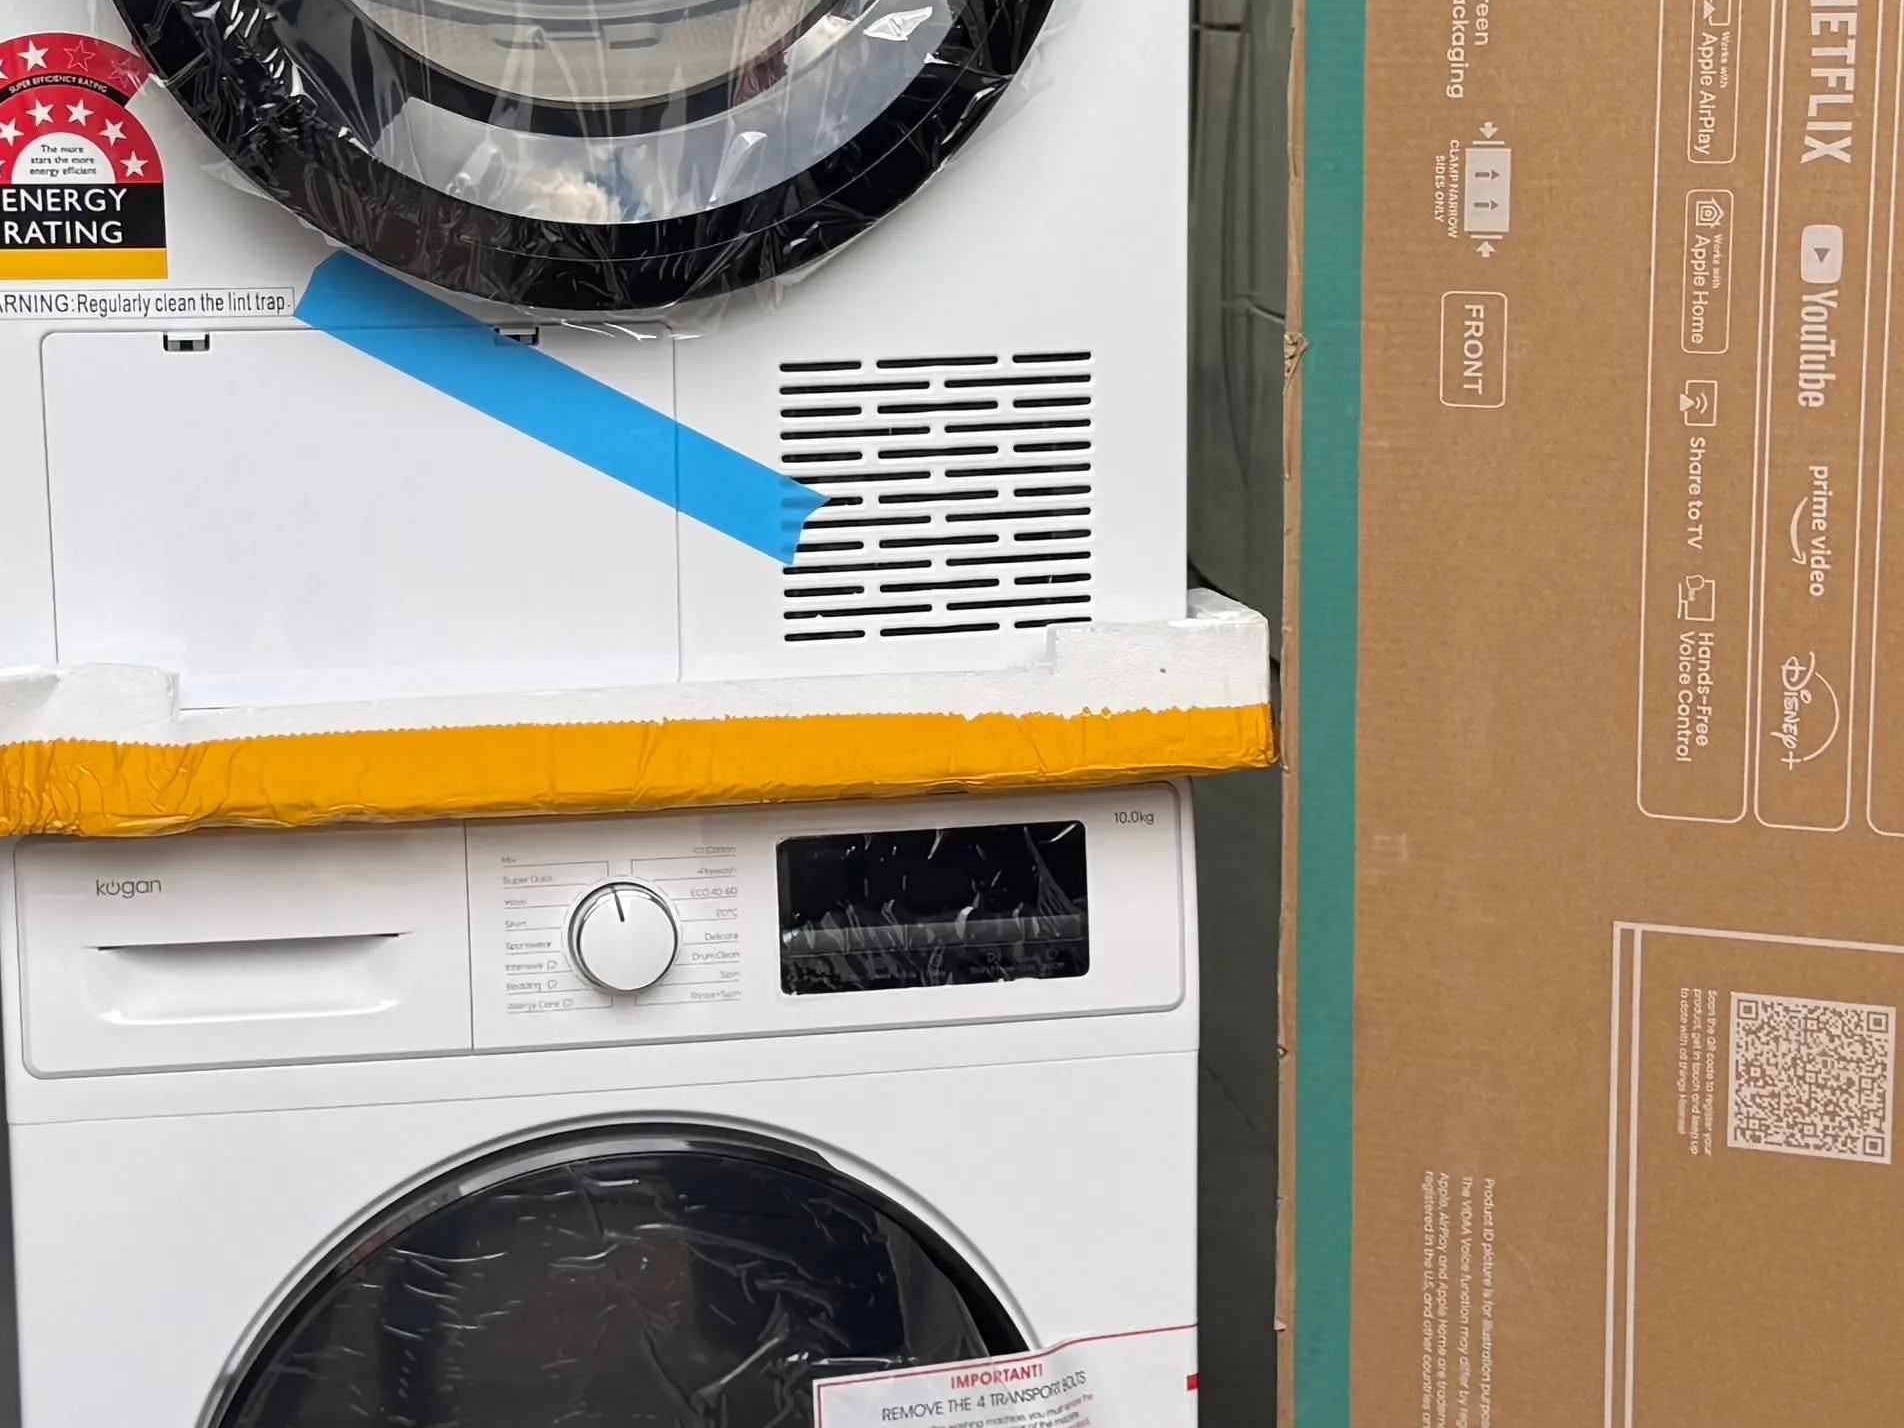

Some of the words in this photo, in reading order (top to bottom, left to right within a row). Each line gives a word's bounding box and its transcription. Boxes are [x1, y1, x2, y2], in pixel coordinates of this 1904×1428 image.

[1699, 32, 1718, 86] Apple
[8, 78, 31, 94] SUPER
[78, 76, 108, 94] RATING
[1693, 90, 1712, 155] AirPlay
[1434, 154, 1446, 184] SIDES
[1447, 139, 1461, 181] CLAMP
[2, 188, 128, 213] ENERGY
[1434, 187, 1446, 223] ONLY
[1446, 183, 1460, 238] NARROW
[4, 220, 124, 244] RATING
[1691, 235, 1710, 287] Apple
[155, 294, 196, 312] clean
[199, 293, 224, 310] the
[228, 291, 252, 310] lint
[1690, 290, 1708, 344] Home
[1462, 304, 1484, 395] FRONT
[1797, 288, 1839, 408] YouTube
[1687, 437, 1707, 496] Share
[1687, 500, 1705, 520] to
[1808, 465, 1834, 531] prime
[1687, 524, 1704, 550] TV
[1808, 535, 1831, 597] video
[1677, 631, 1695, 684] Voice
[1695, 631, 1715, 746] Hands-Free
[1676, 690, 1693, 762] Control
[1115, 811, 1153, 825] 10.0kg
[96, 879, 162, 899] kogan
[704, 932, 738, 941] Delicate
[951, 1363, 1044, 1390] IMPORTANT!
[882, 1400, 944, 1422] REMOVE
[948, 1398, 971, 1414] THE
[976, 1395, 985, 1408] 4
